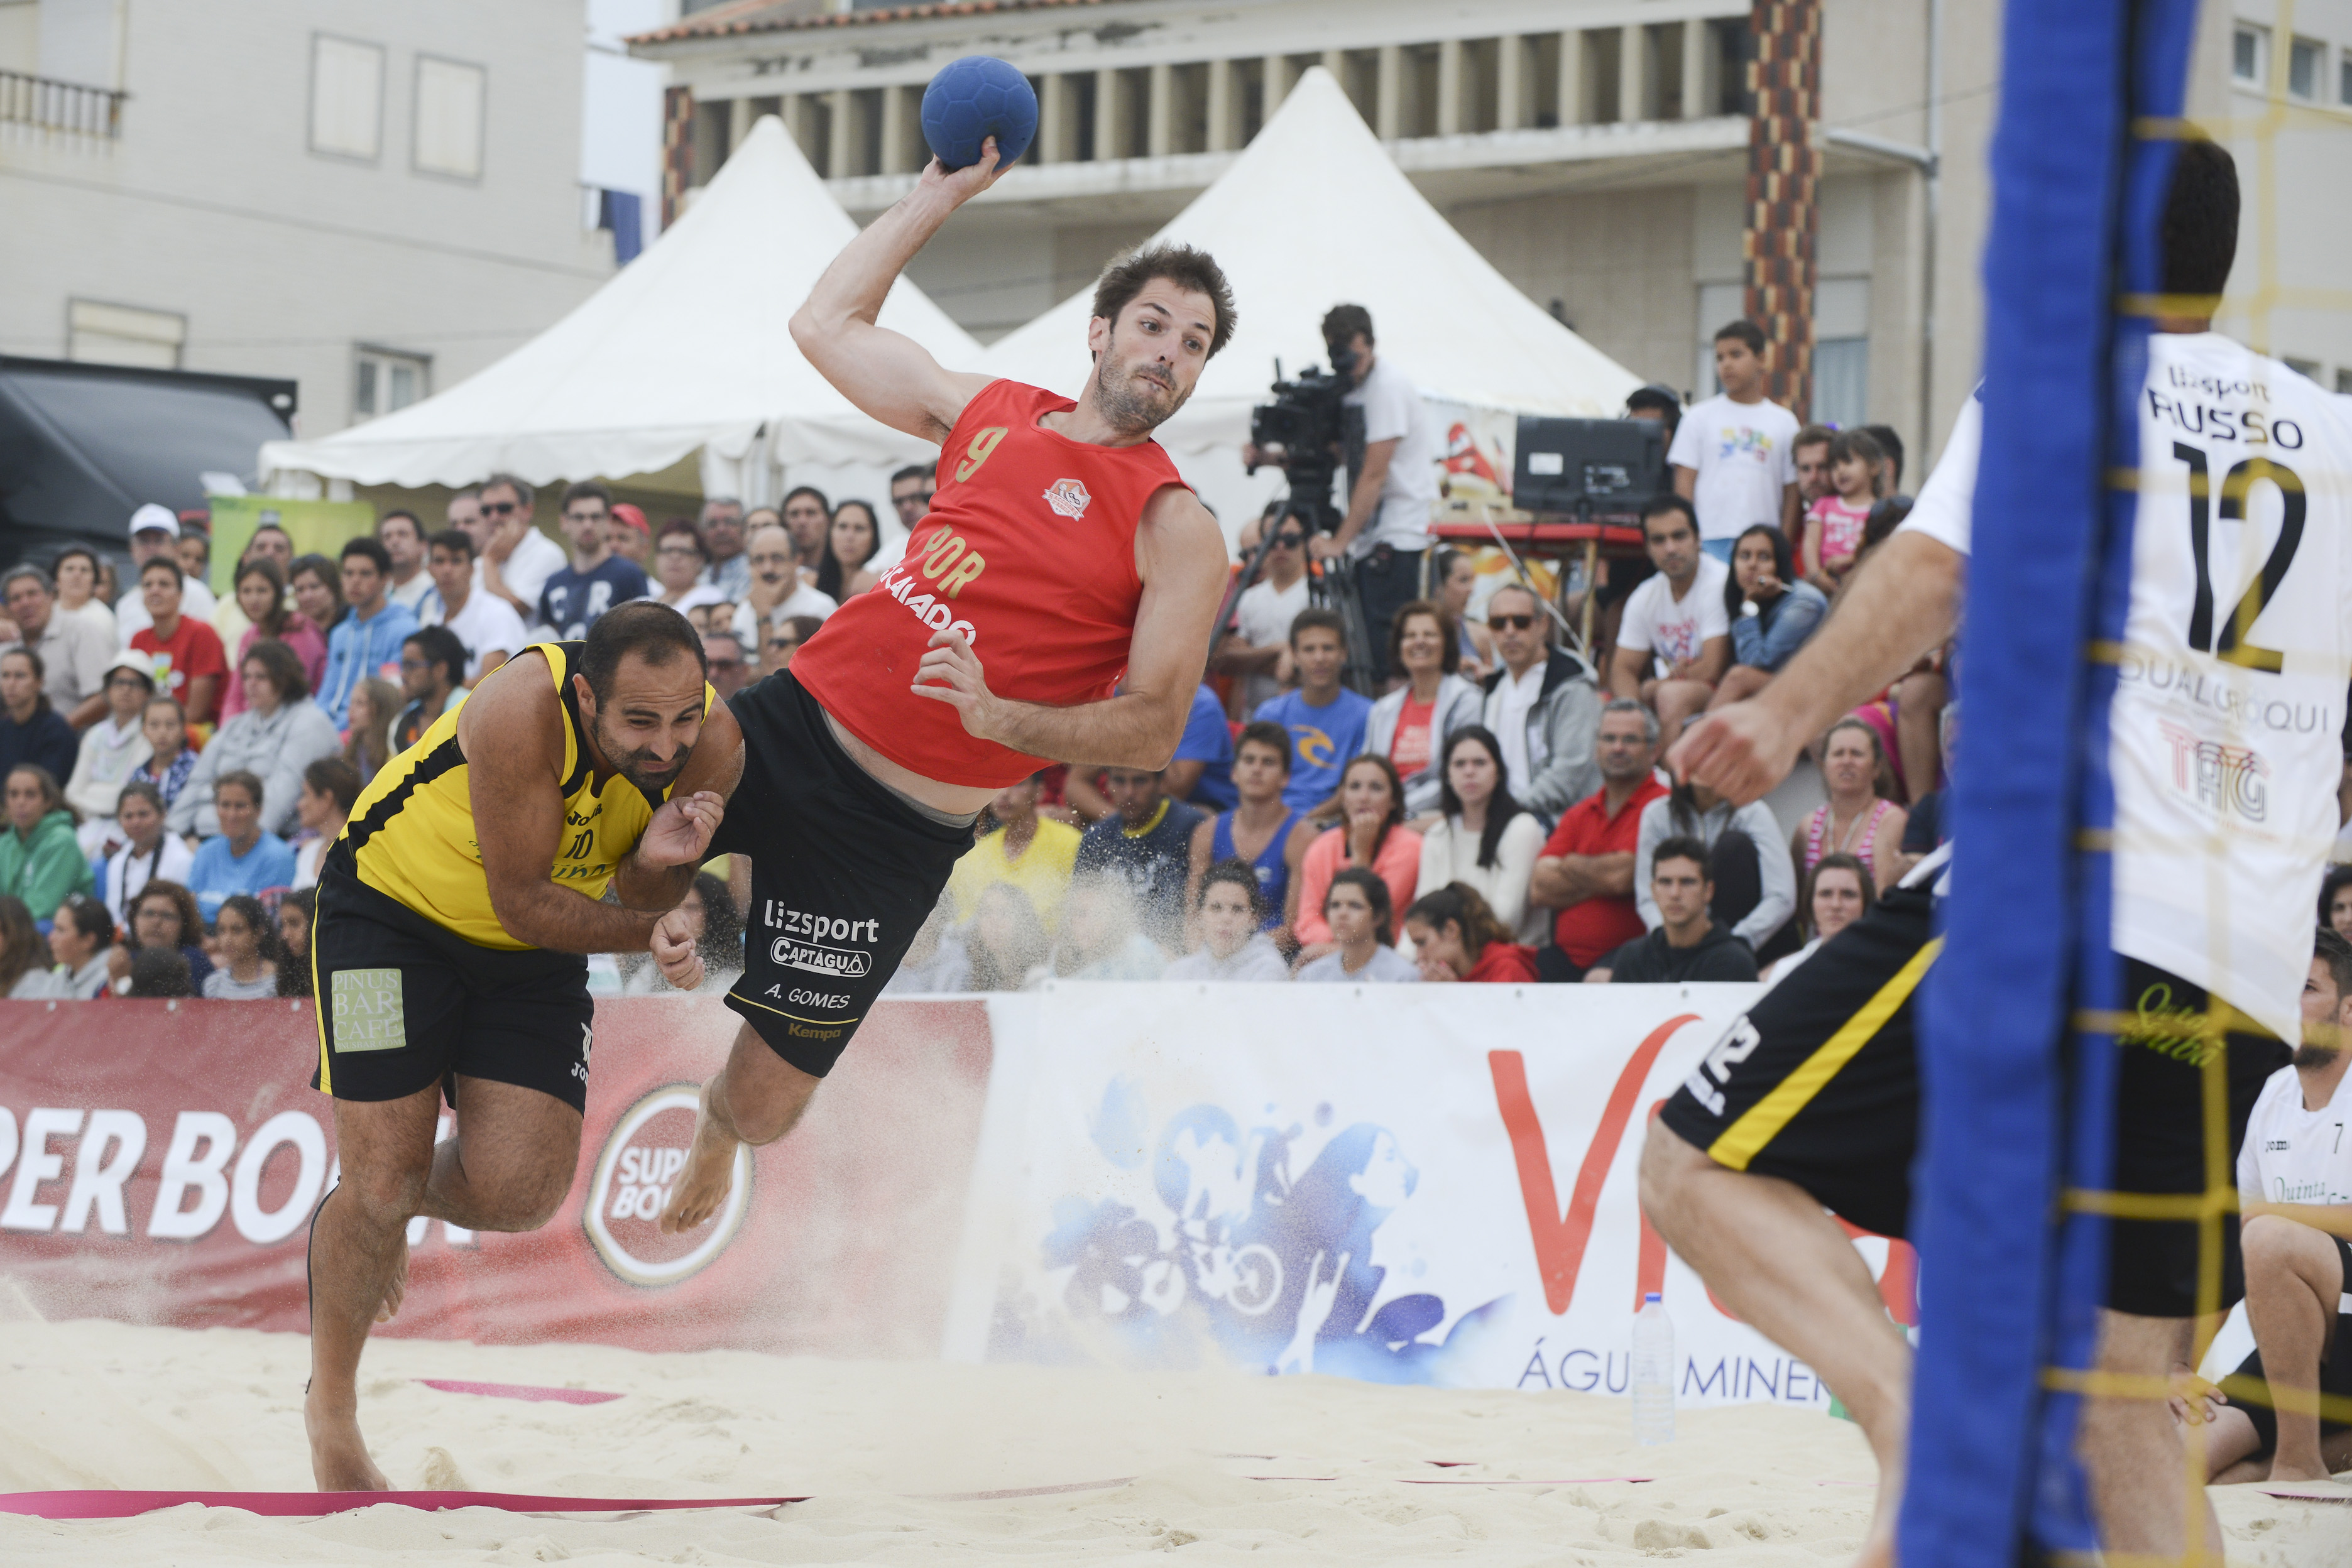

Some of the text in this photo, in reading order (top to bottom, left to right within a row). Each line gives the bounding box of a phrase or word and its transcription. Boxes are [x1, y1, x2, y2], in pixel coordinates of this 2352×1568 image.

[2148, 388, 2304, 450] RUSSO
[955, 427, 1009, 483] 9
[912, 524, 986, 600] POR
[2173, 440, 2307, 675] 12
[563, 829, 594, 859] 10
[764, 899, 880, 943] lizsport
[334, 972, 398, 991] PINUS
[765, 984, 850, 1010] A. GOMES
[334, 991, 399, 1016] BAR
[335, 1013, 402, 1041] CAFÉ
[789, 1023, 841, 1042] Kempa
[2334, 1122, 2343, 1154] 7
[618, 1146, 692, 1185] SUP
[1516, 1336, 1630, 1393] ÁGU
